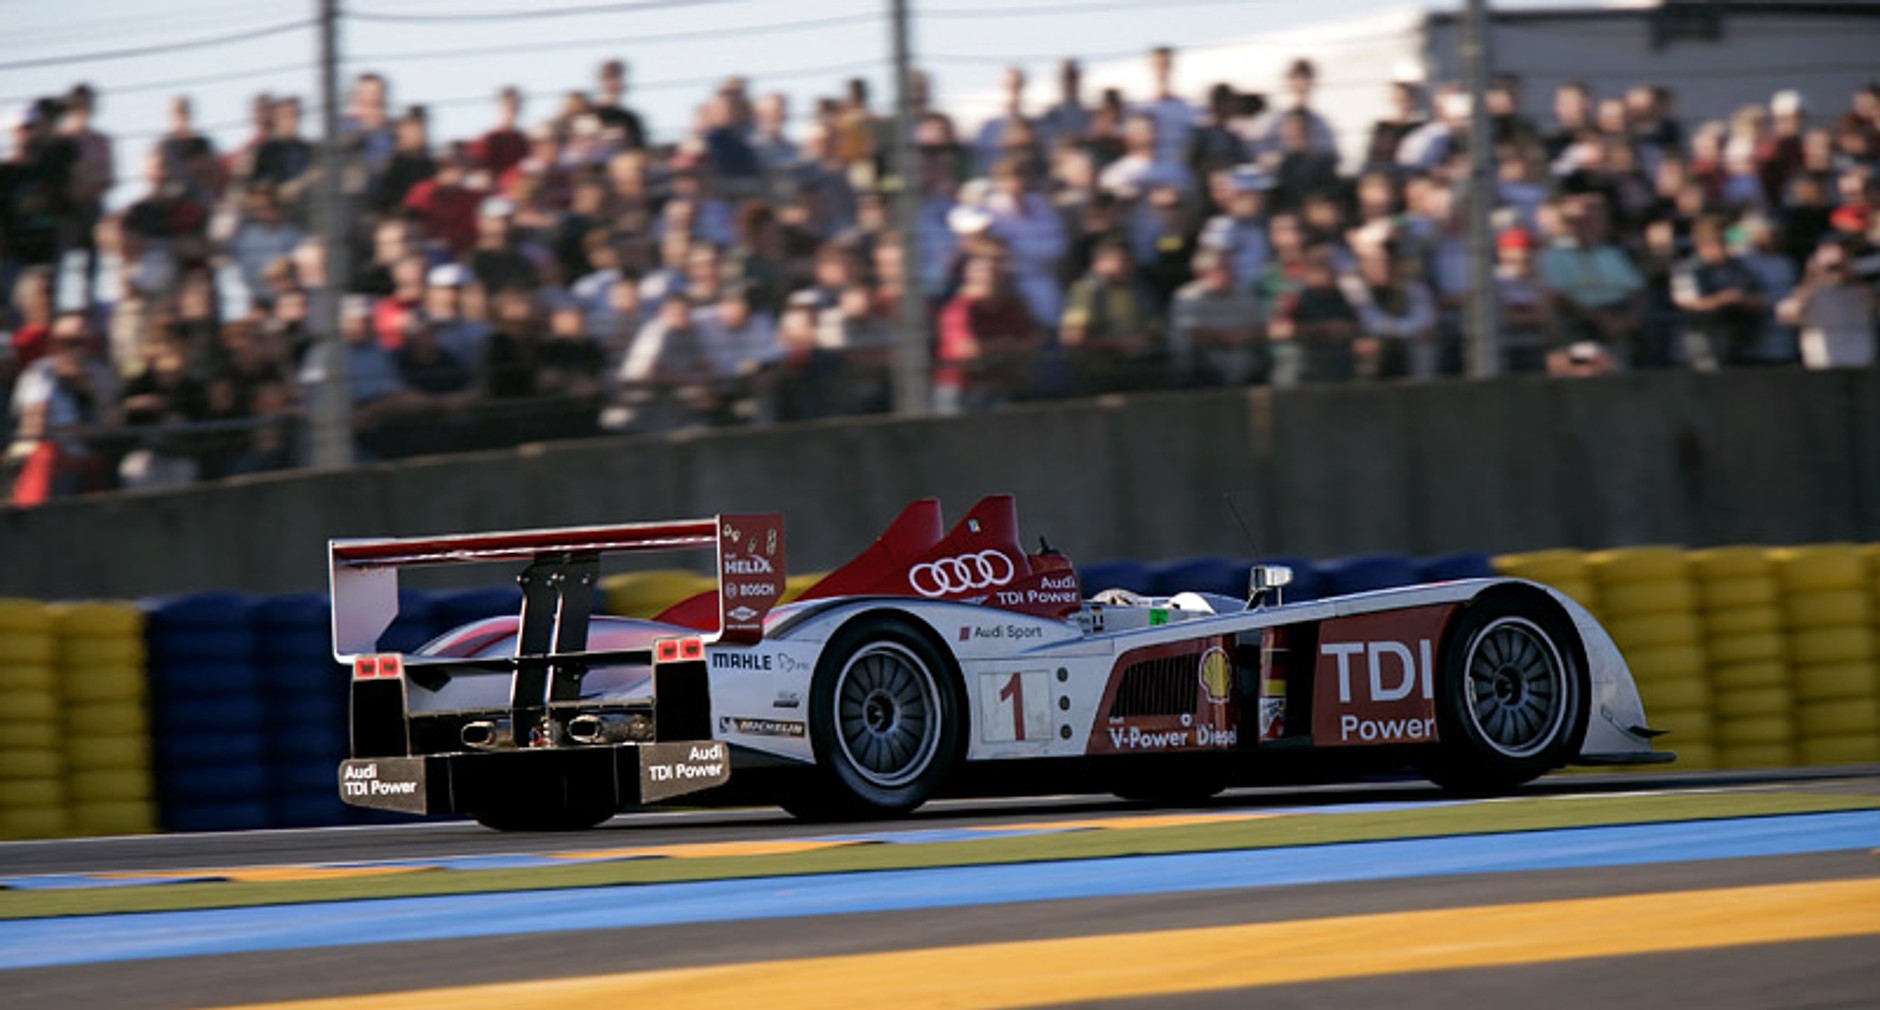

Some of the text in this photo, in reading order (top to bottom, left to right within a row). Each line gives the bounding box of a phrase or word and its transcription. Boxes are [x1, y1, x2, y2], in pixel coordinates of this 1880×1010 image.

[724, 554, 774, 574] HELIX
[740, 584, 774, 597] BOSCH
[1041, 576, 1076, 589] Audi
[997, 590, 1077, 605] TDI Power
[975, 625, 1043, 640] Audi Sport
[712, 653, 772, 671] MAHLE
[1320, 639, 1434, 704] TDI
[1000, 672, 1026, 741] 1
[1108, 723, 1238, 749] V-Power Diesel
[1341, 714, 1436, 741] Power
[689, 744, 723, 760] Audi
[344, 764, 377, 780] Audi
[648, 763, 723, 781] TDI Power
[344, 780, 418, 796] TDI Power
